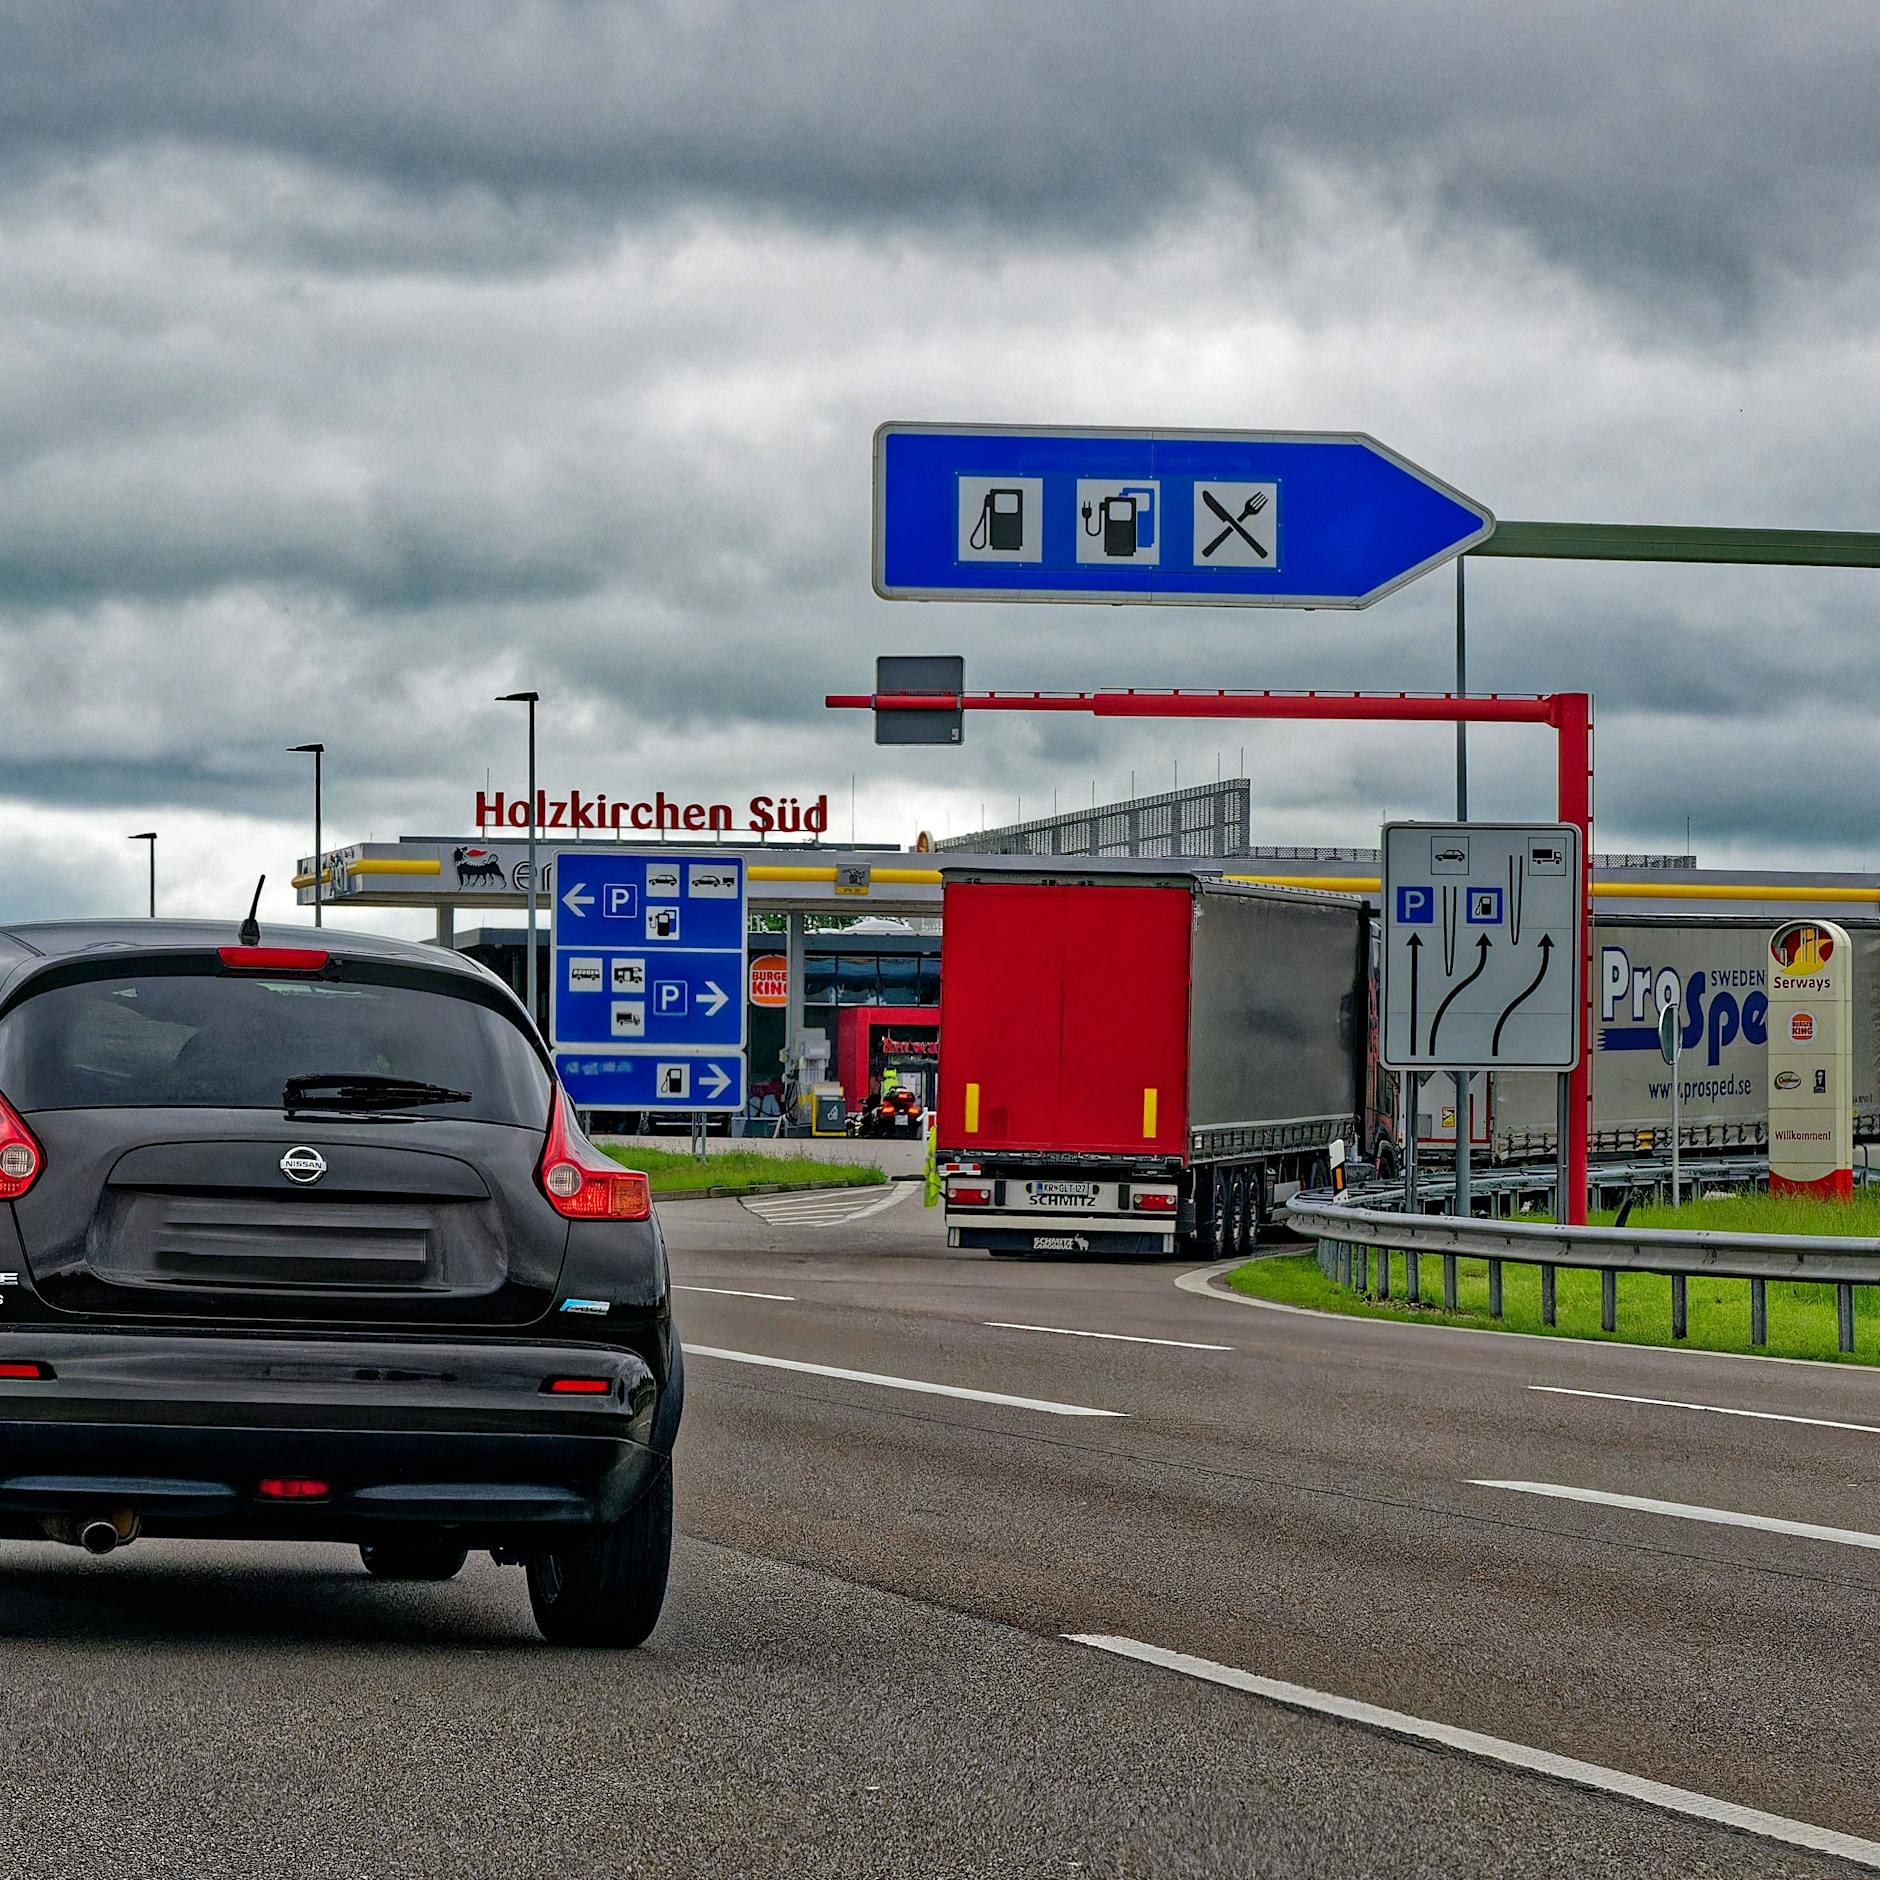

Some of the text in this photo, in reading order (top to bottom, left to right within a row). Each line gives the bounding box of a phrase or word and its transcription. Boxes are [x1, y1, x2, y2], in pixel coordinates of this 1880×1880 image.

[476, 790, 828, 833] Holzkirchen Süd
[611, 889, 630, 913] P
[1405, 891, 1425, 918] P
[752, 971, 787, 981] BURGE
[1711, 970, 1766, 987] SWEDEN
[1774, 976, 1831, 991] Serways
[661, 986, 680, 1010] P
[1791, 1027, 1813, 1035] KING
[1775, 1130, 1831, 1141] Willkommen!
[285, 1160, 322, 1169] NISSAN
[1029, 1194, 1097, 1207] SCHMITZ
